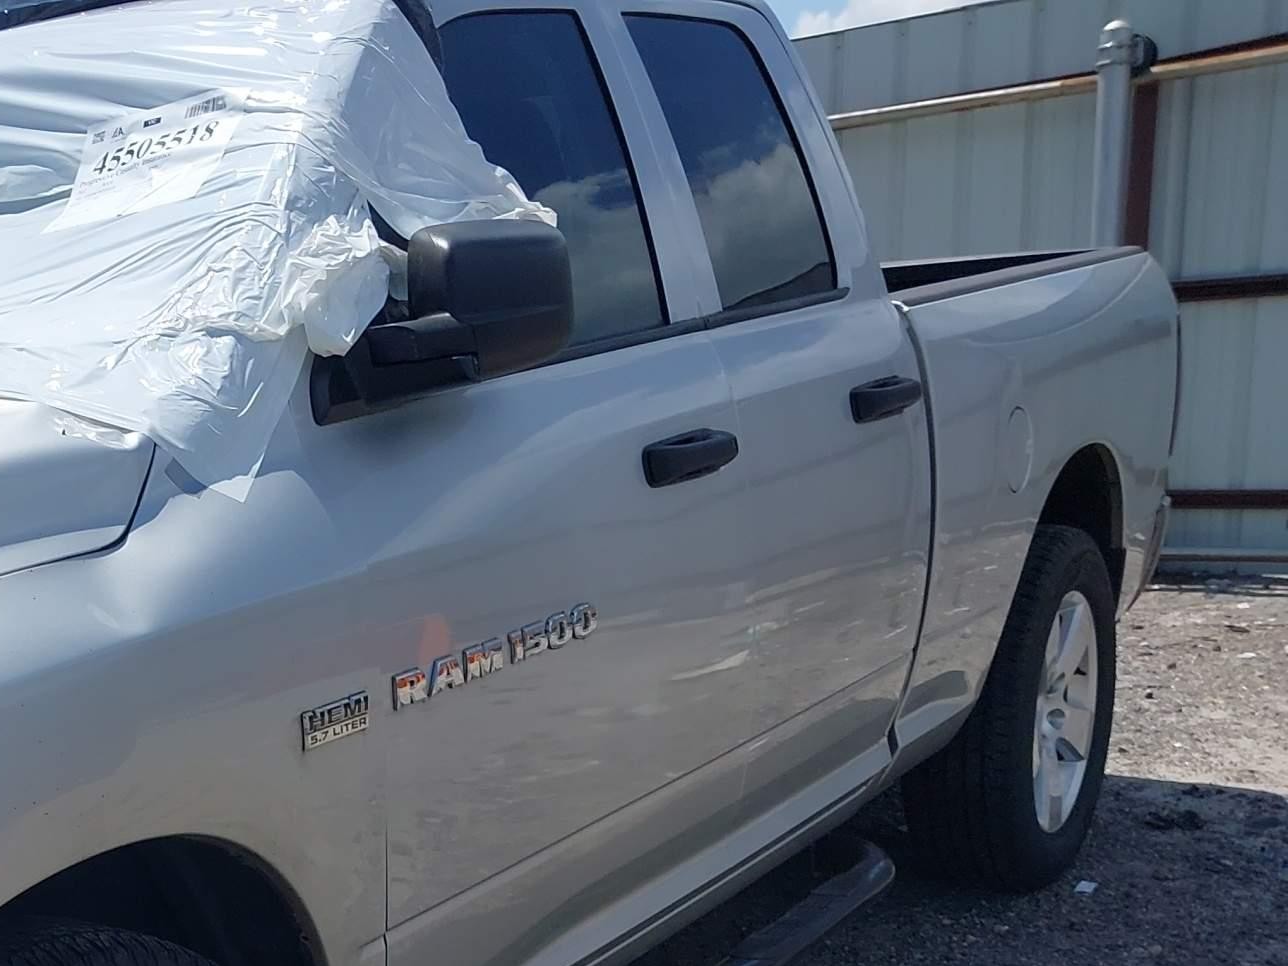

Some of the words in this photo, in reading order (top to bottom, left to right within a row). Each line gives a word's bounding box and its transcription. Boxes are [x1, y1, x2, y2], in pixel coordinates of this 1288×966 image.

[93, 120, 220, 175] 45505518
[392, 637, 504, 711] RAM
[507, 602, 598, 664] 1500
[304, 692, 369, 733] HEMI
[310, 730, 329, 746] 5.7
[332, 717, 367, 736] LITER
